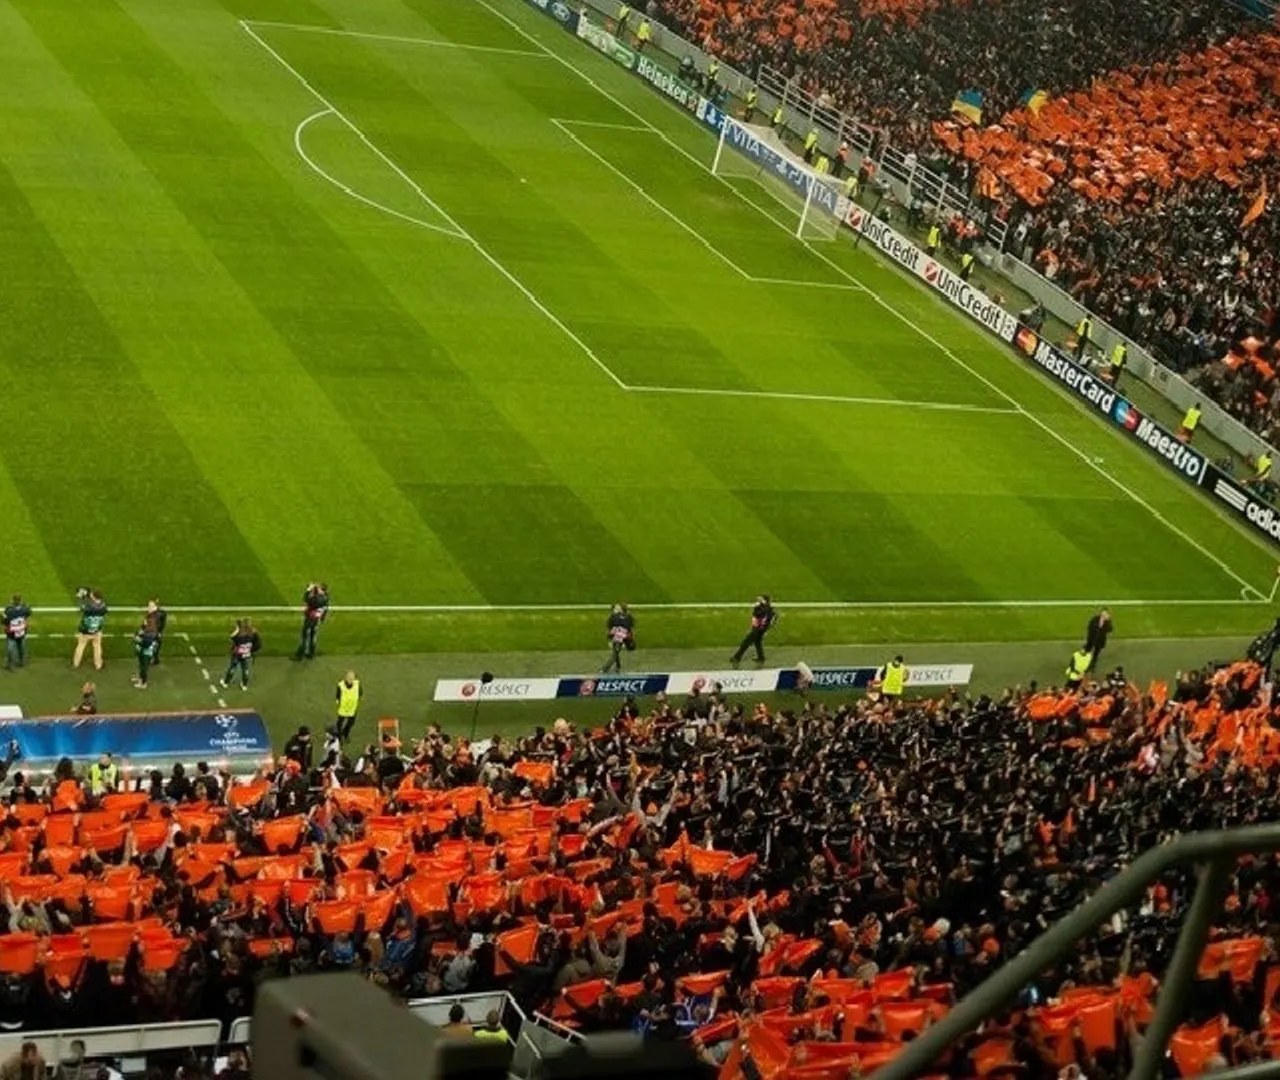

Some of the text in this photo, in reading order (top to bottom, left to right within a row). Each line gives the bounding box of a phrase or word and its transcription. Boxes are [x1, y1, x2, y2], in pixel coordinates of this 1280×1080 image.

[637, 54, 690, 105] Heineken
[861, 214, 920, 269] UniCredit
[937, 273, 1002, 332] UniCredit
[1034, 340, 1116, 414] MasterCard
[1135, 419, 1201, 476] Maestro
[596, 680, 647, 692] RESPECT
